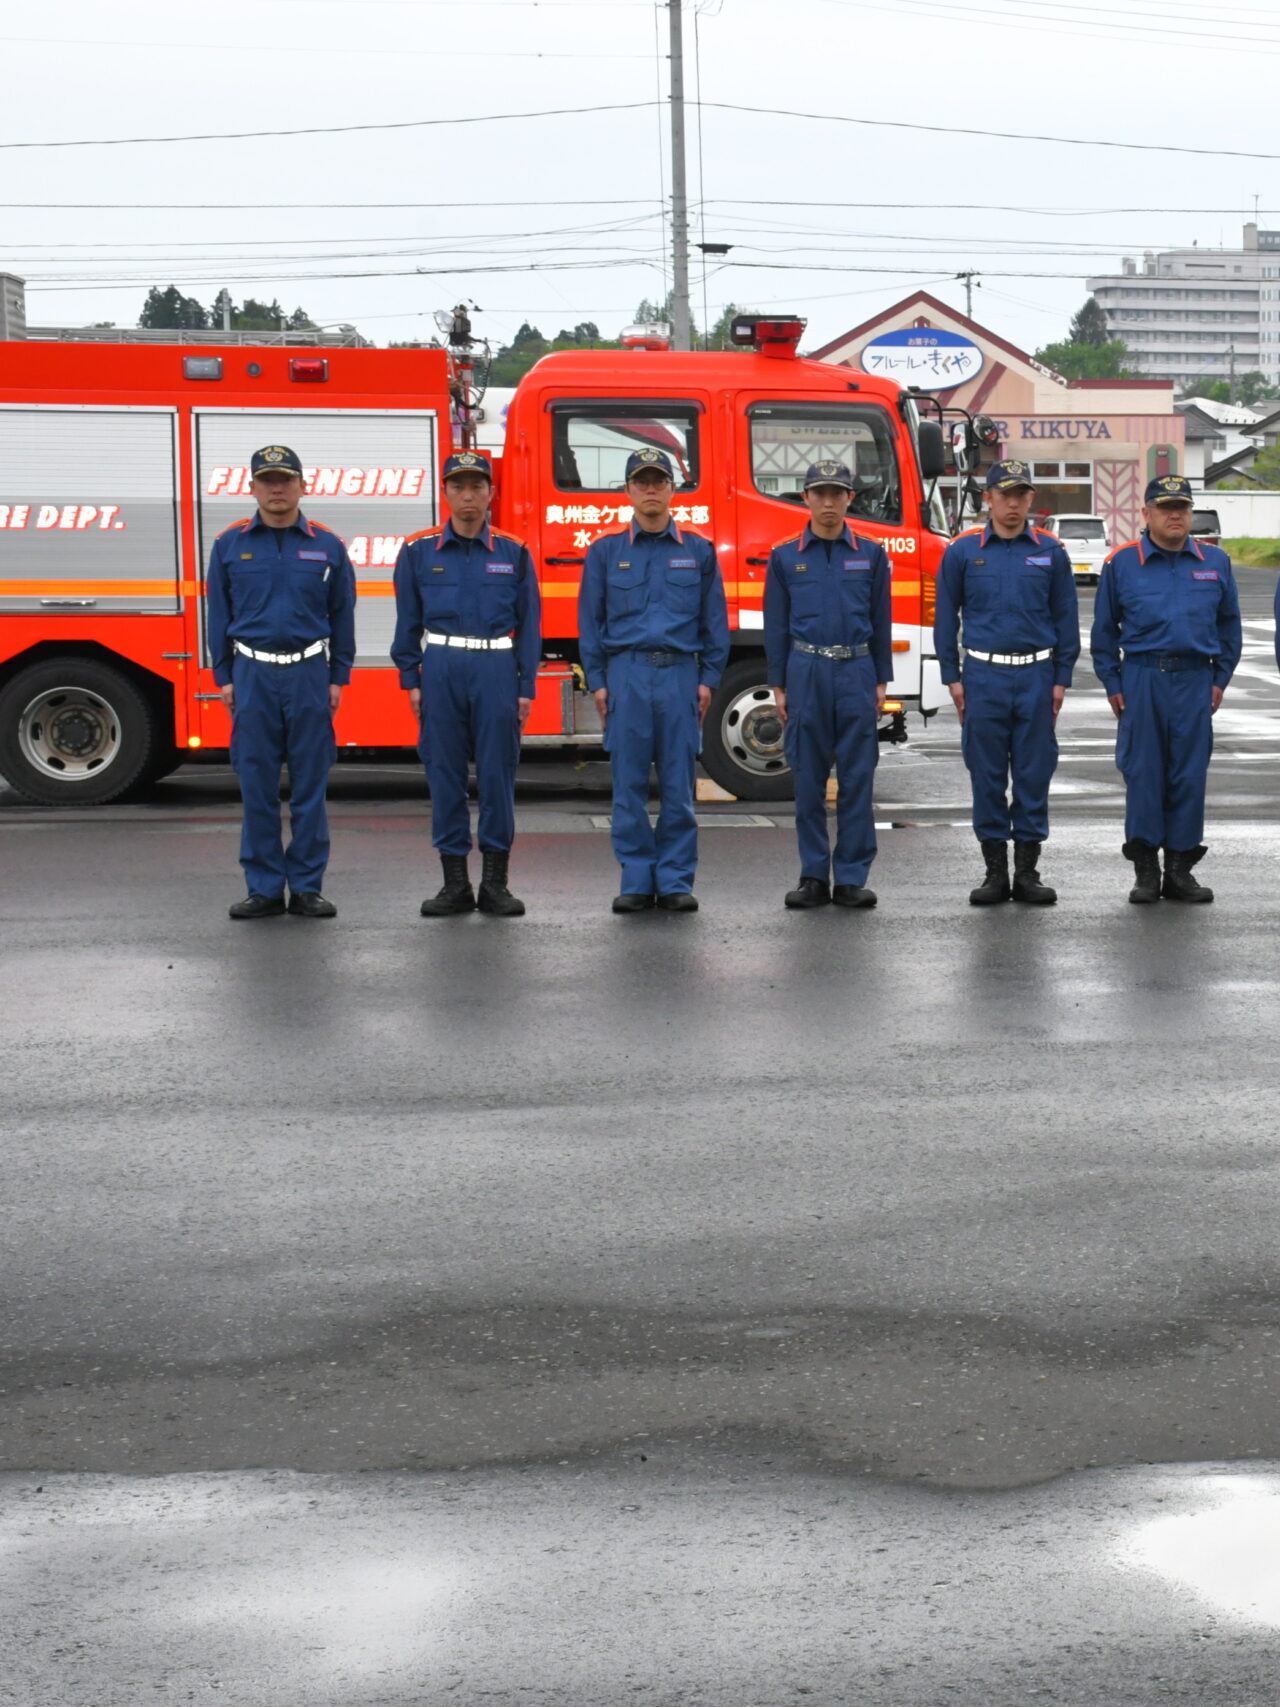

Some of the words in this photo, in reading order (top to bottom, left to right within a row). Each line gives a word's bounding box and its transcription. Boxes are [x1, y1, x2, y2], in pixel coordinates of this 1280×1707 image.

[907, 337, 938, 346] お菓子の
[1020, 420, 1112, 439] KIKUYA
[302, 467, 425, 496] ENGINE
[37, 505, 127, 531] DEPT.
